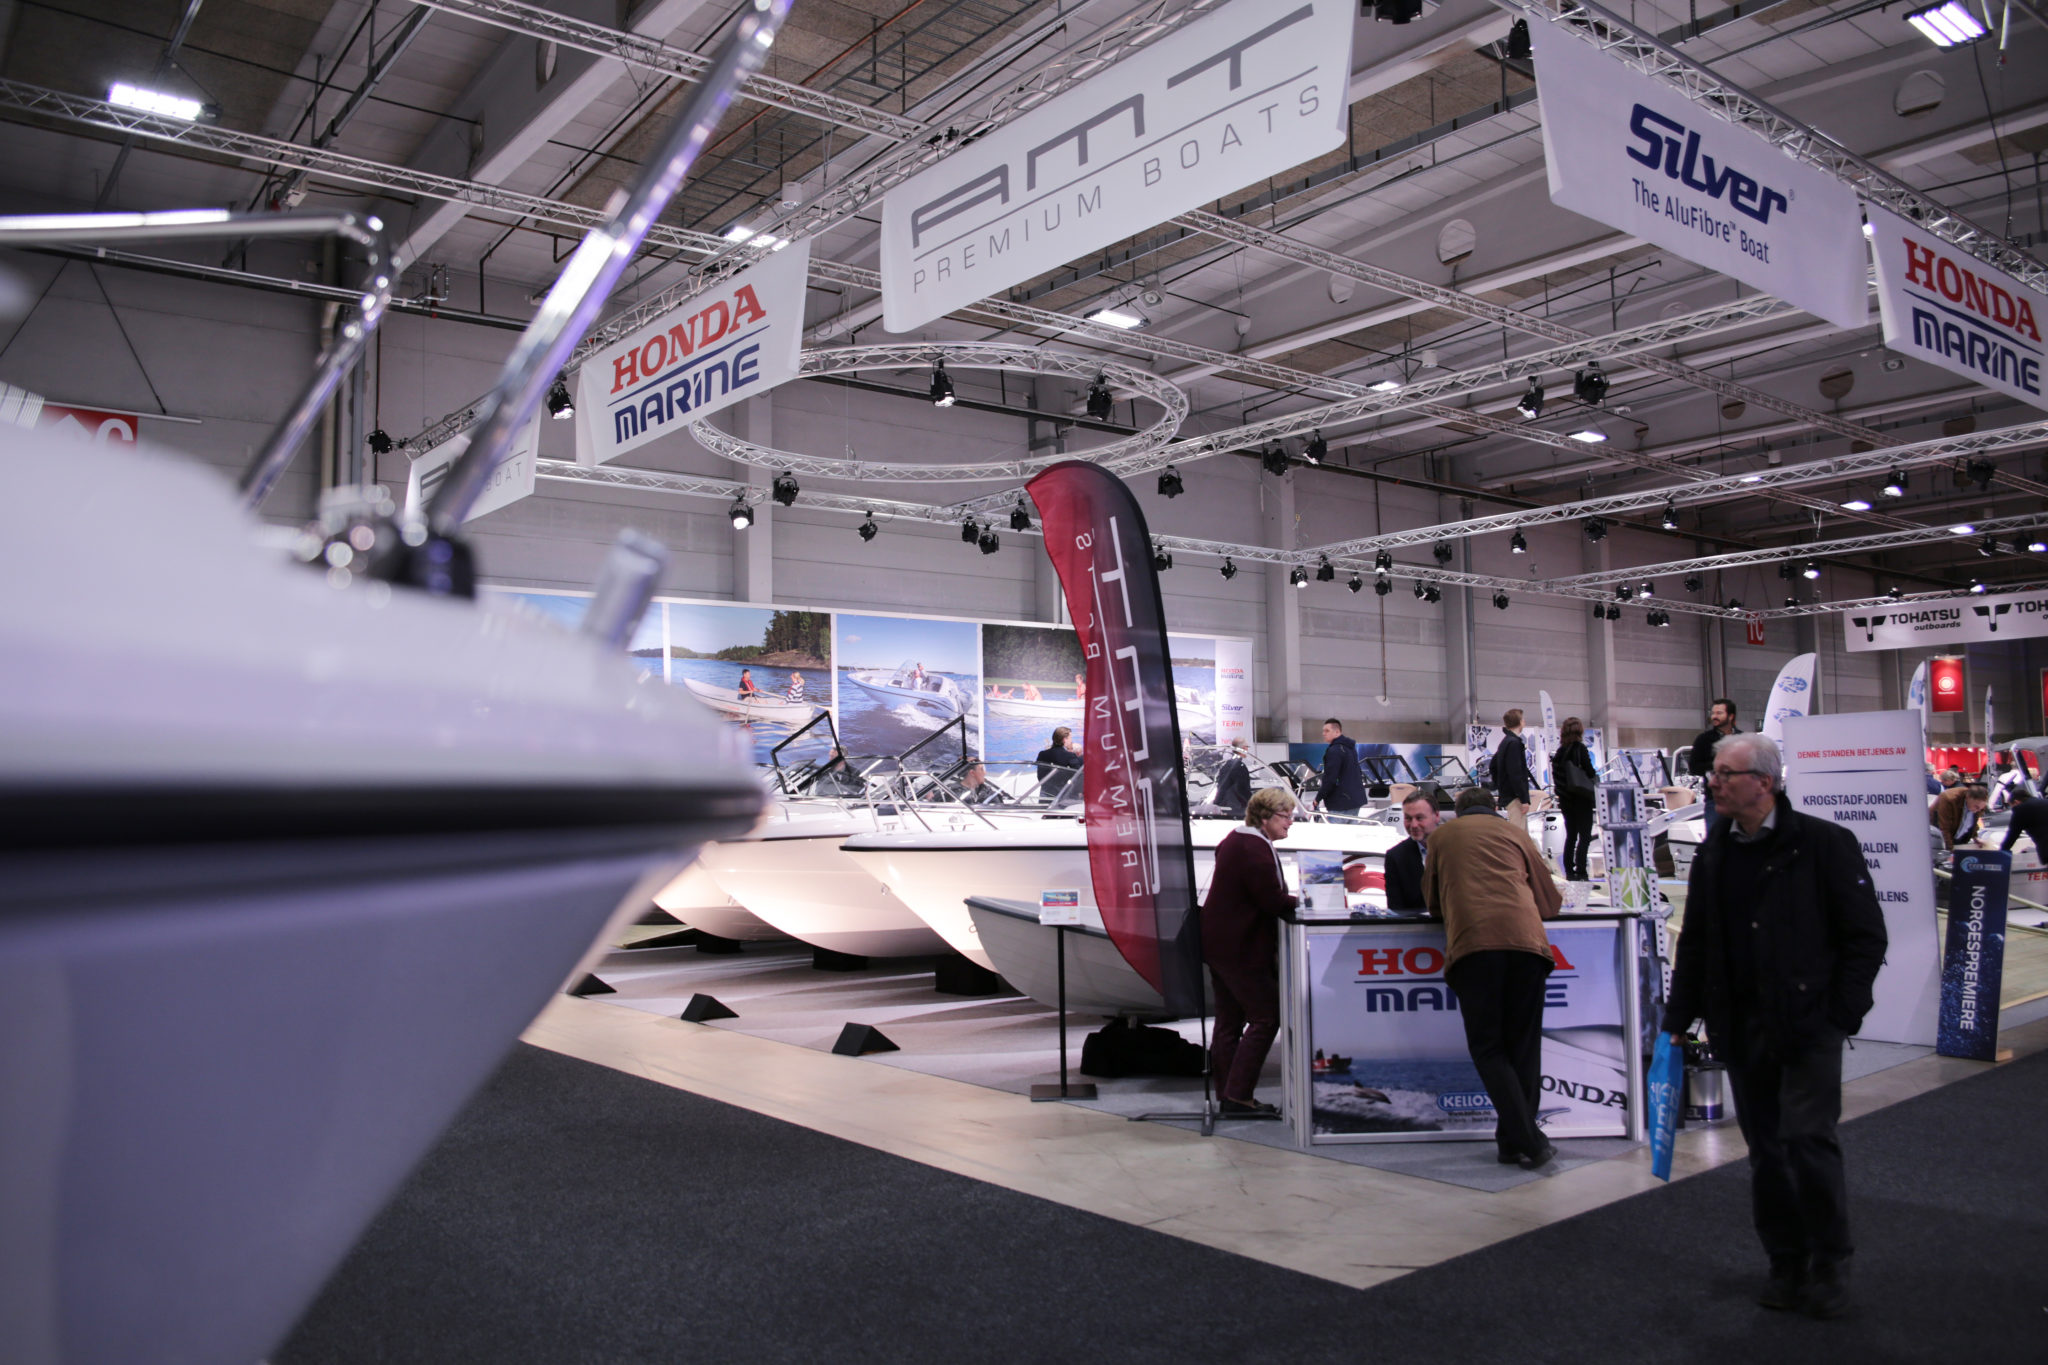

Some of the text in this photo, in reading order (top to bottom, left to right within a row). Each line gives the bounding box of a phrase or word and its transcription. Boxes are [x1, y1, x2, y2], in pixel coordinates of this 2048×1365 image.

[914, 85, 1320, 294] PREMIUM BOATS
[1632, 178, 1659, 213] The
[1740, 230, 1770, 264] Boat
[1903, 237, 2042, 343] HONDA
[610, 283, 767, 395] HONDA
[1912, 306, 2040, 396] MARINE
[615, 343, 760, 445] MARINE
[1890, 608, 1961, 625] TOHATSU
[1914, 621, 1961, 631] outboards
[1797, 747, 1907, 759] DENNE STANDEN BETJENES AV
[1803, 794, 1908, 806] KROGSTADFJORDEN
[1834, 810, 1877, 821] MARINA
[1875, 890, 1909, 903] ILENS
[1960, 885, 1986, 1031] NORGESPREMIERE
[1541, 1075, 1627, 1111] ONDA
